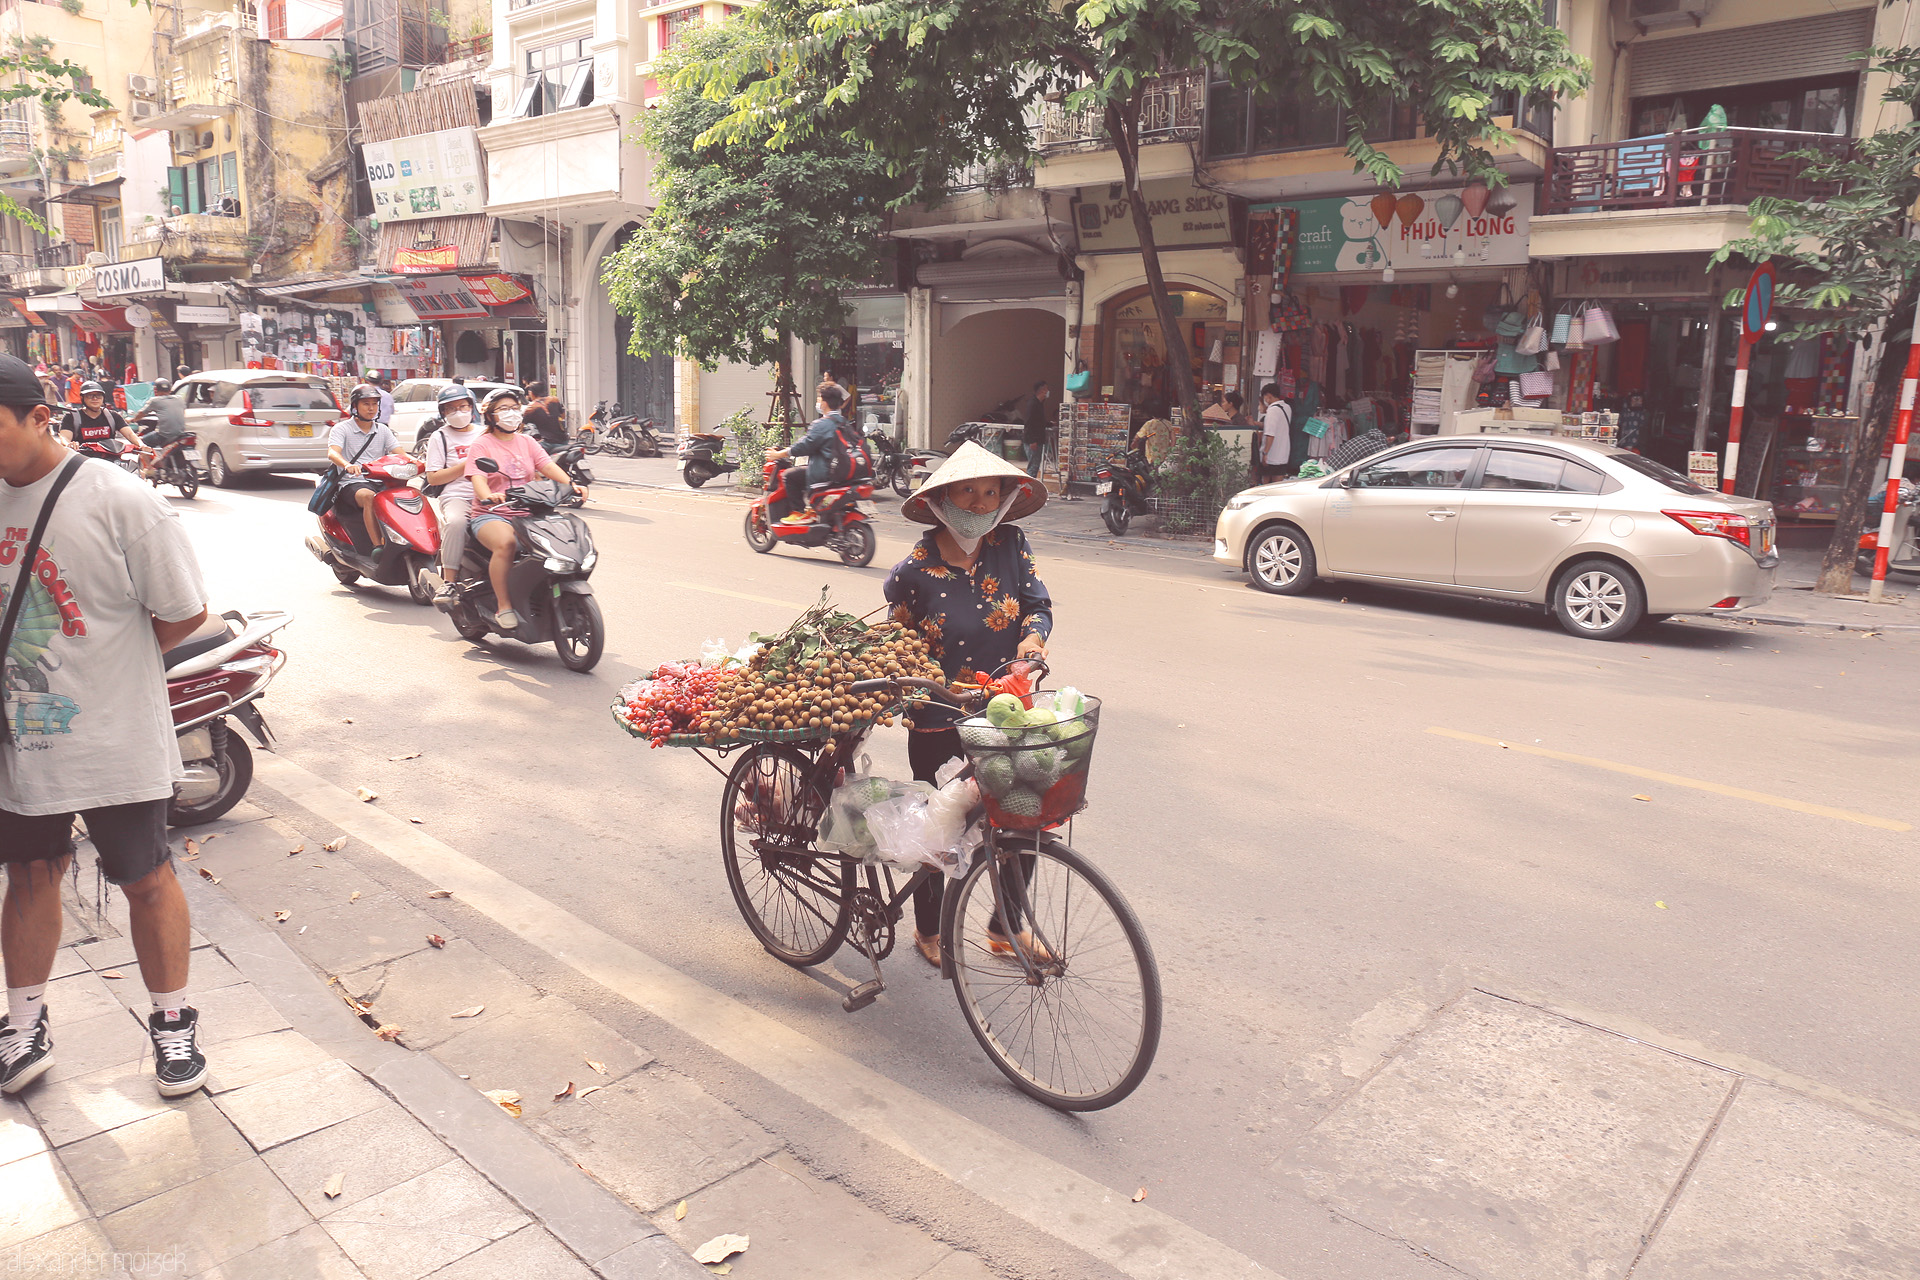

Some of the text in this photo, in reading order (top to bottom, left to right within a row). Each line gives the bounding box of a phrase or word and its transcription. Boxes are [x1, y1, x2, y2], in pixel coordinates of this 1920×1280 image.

[368, 163, 395, 181] BOLD
[1298, 225, 1332, 243] craft
[1466, 217, 1514, 237] LONG
[96, 266, 140, 292] COSMO
[151, 279, 161, 288] spa
[892, 340, 903, 349] Silk
[5, 527, 28, 541] THE
[182, 677, 230, 694] LEAD
